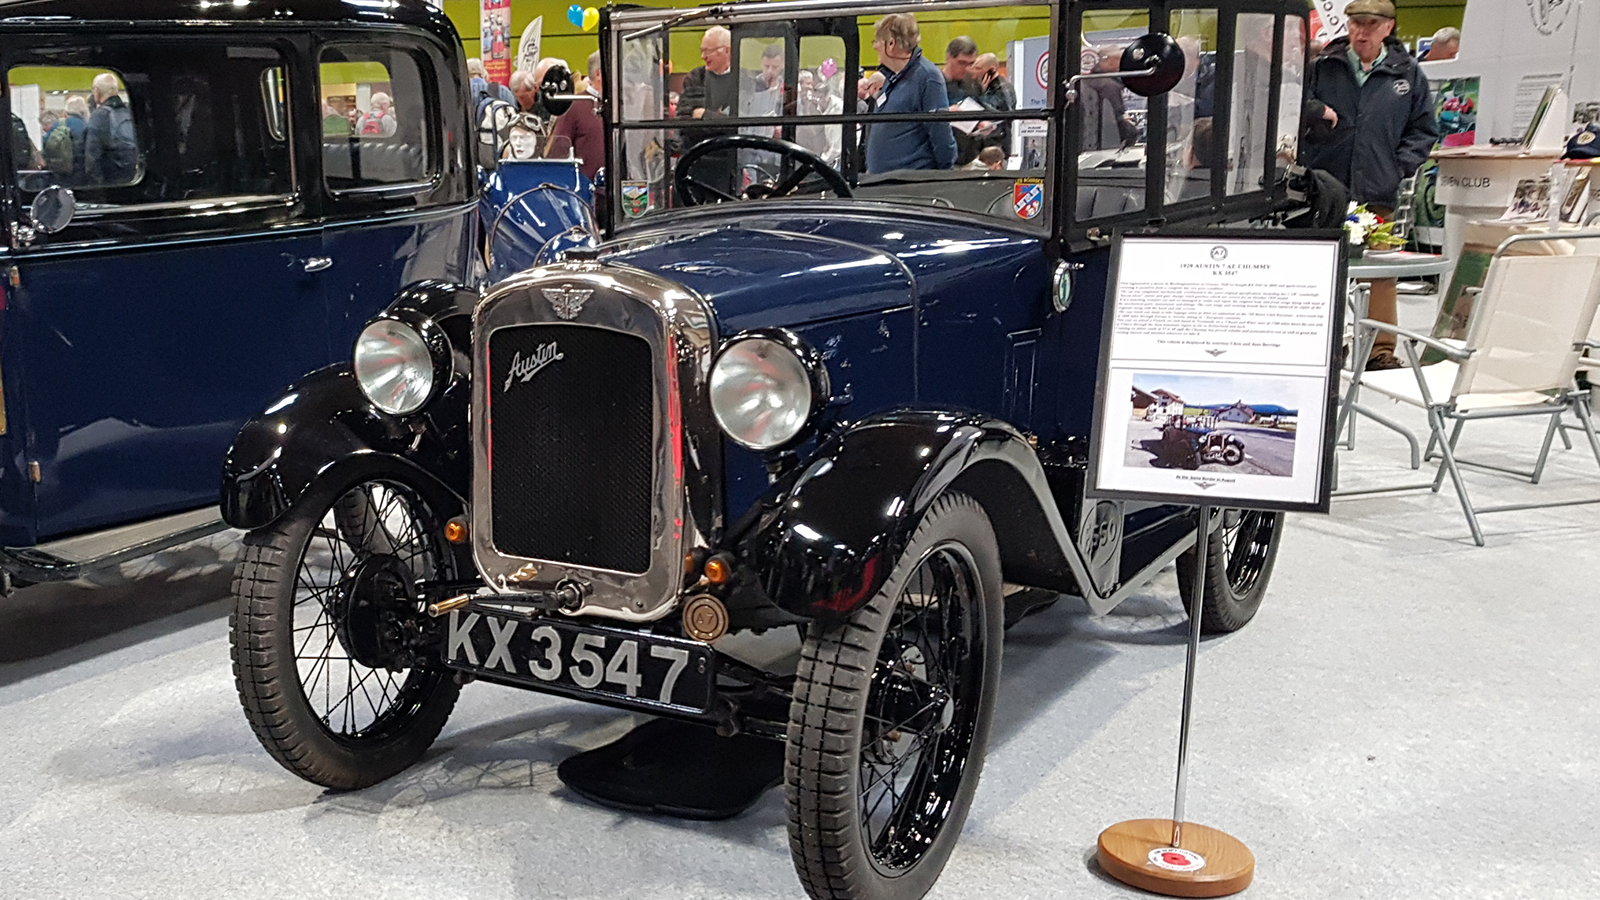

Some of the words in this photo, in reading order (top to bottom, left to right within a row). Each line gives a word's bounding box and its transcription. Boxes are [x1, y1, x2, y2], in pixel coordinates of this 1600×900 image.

[1462, 177, 1490, 187] CLUB
[503, 341, 564, 392] Austin
[448, 609, 518, 674] KX
[528, 626, 689, 704] 3547
